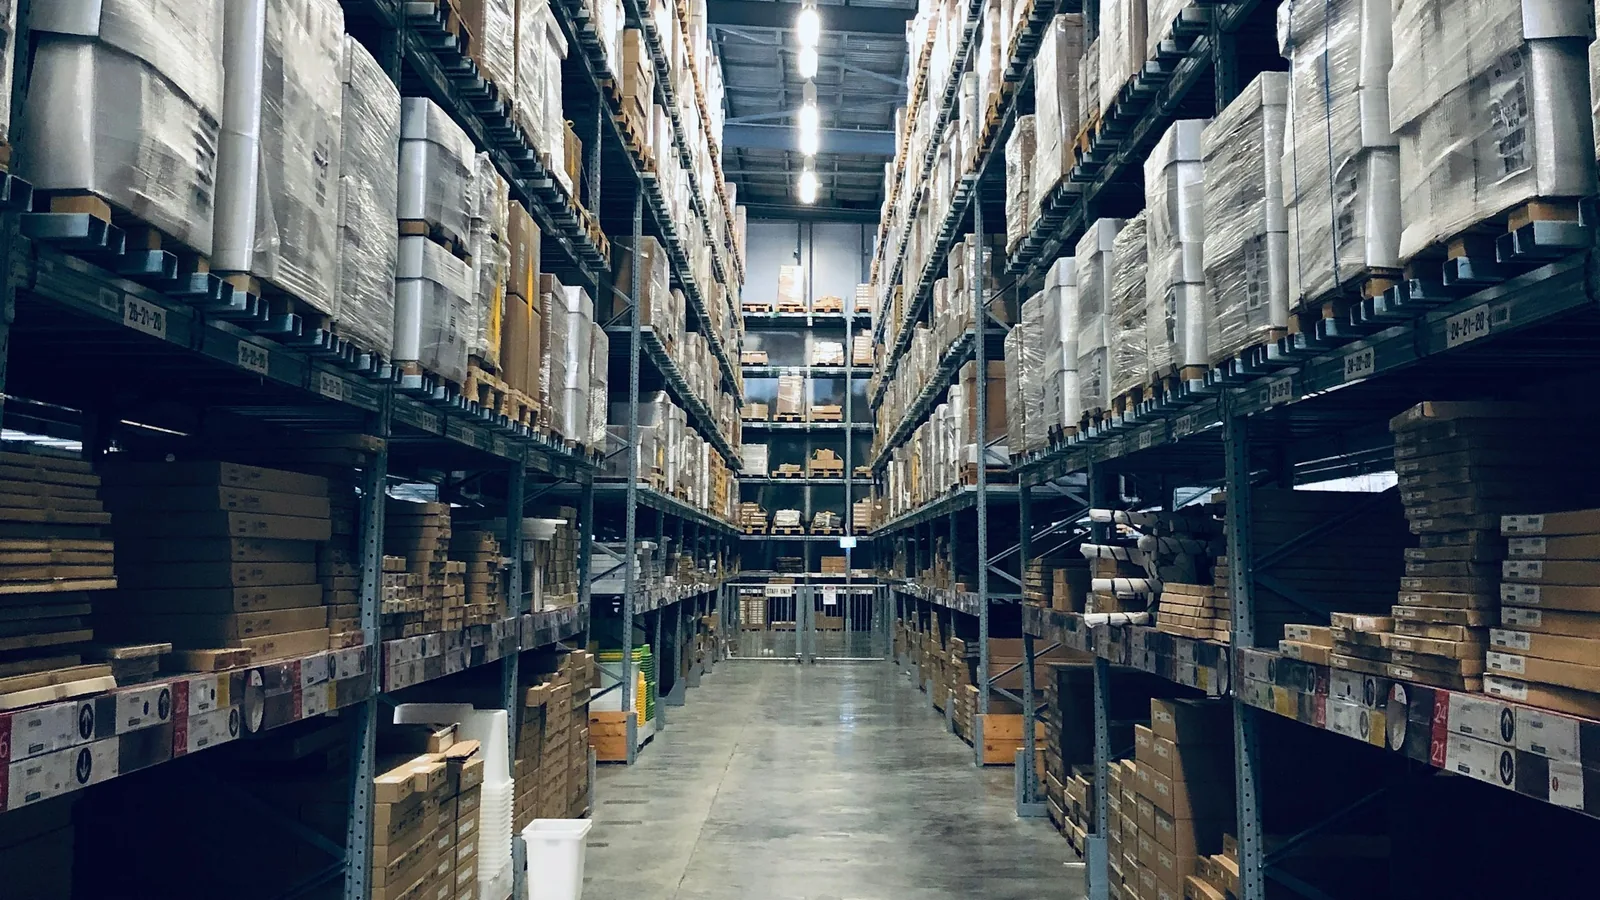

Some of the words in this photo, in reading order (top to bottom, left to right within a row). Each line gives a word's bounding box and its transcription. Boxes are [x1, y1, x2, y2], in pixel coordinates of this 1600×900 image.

[1451, 311, 1484, 340] 24-21-20
[1434, 702, 1447, 724] 24
[1432, 740, 1445, 763] 21
